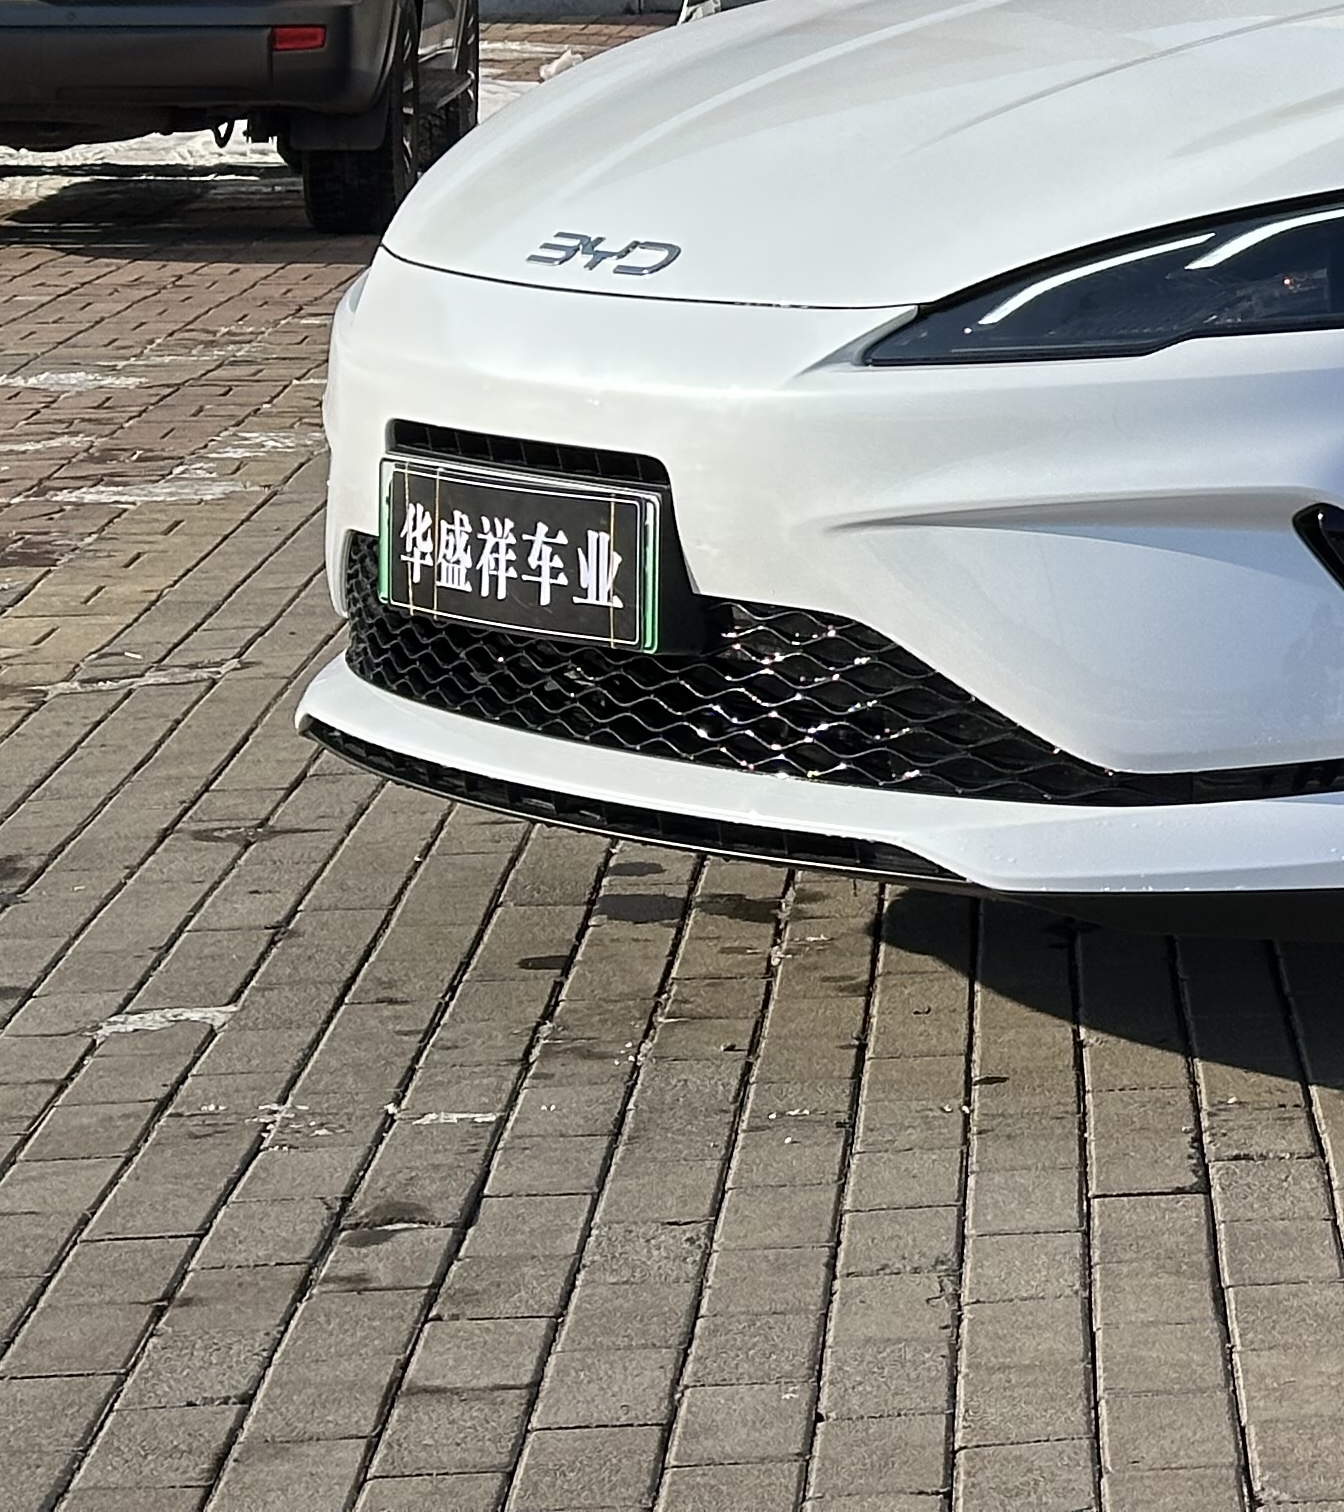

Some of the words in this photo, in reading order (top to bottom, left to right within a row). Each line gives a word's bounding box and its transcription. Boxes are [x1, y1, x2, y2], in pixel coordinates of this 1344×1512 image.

[526, 231, 681, 276] BYD
[399, 502, 624, 609] 华盛祥车业
